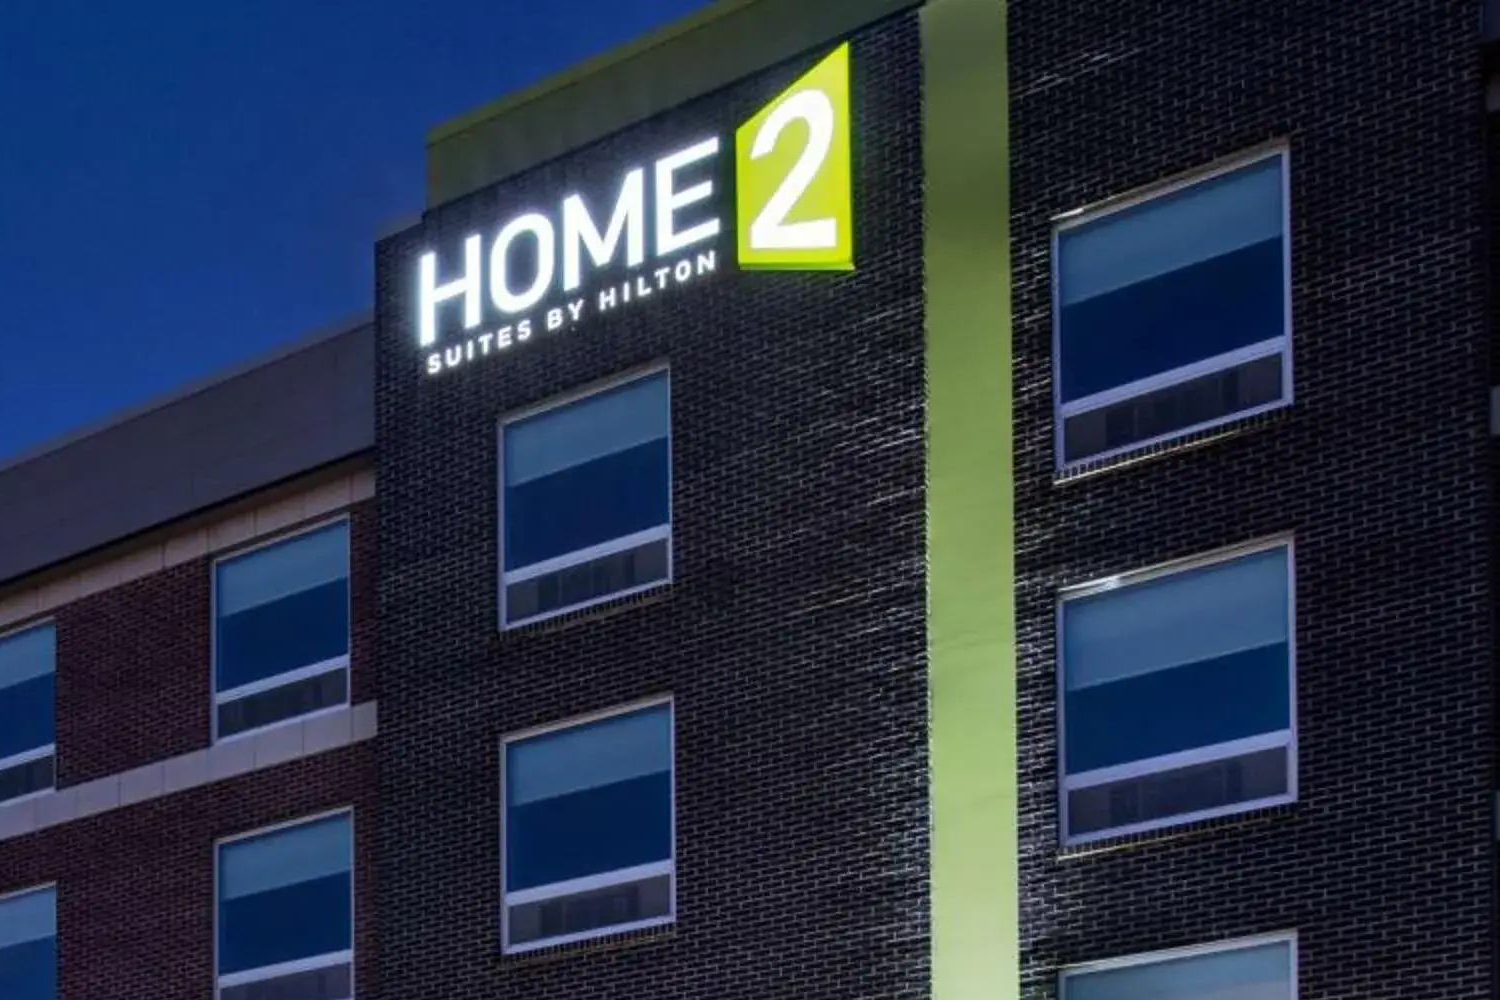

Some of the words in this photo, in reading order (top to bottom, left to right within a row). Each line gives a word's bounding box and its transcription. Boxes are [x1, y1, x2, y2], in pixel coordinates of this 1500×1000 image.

[417, 135, 721, 348] HOME
[749, 88, 838, 249] 2
[426, 321, 532, 375] SUITES
[547, 296, 585, 330] BY
[599, 249, 718, 311] HILTON
